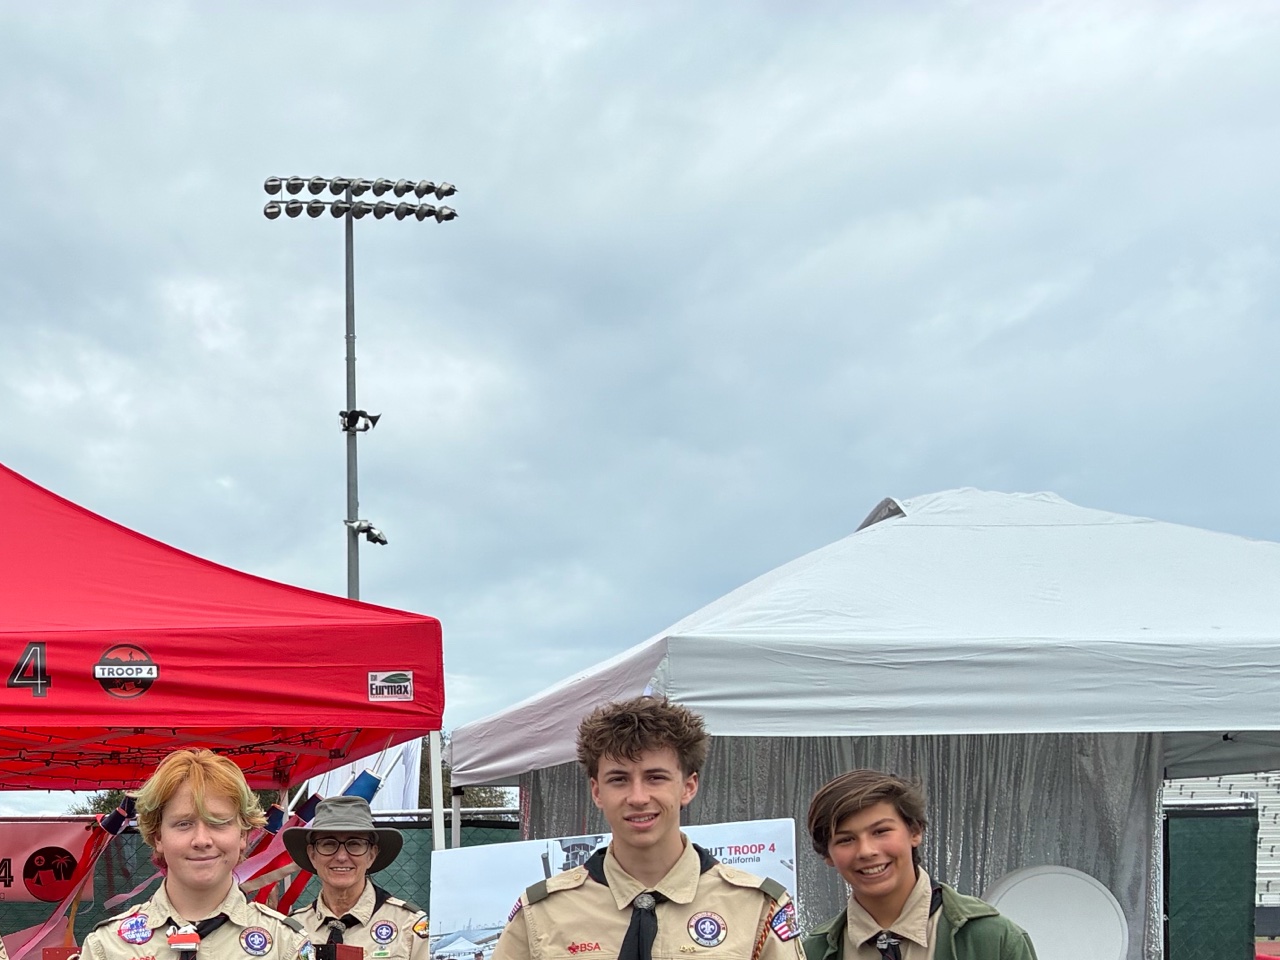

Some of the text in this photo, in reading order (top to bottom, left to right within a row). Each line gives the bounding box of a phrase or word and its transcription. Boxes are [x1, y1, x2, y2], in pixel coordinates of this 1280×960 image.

[6, 641, 52, 698] 4
[100, 667, 154, 676] TROOP 4
[369, 683, 409, 696] Eurmax
[727, 844, 766, 856] TROOP
[768, 843, 776, 853] 4
[721, 855, 761, 865] California
[580, 942, 601, 952] BSA
